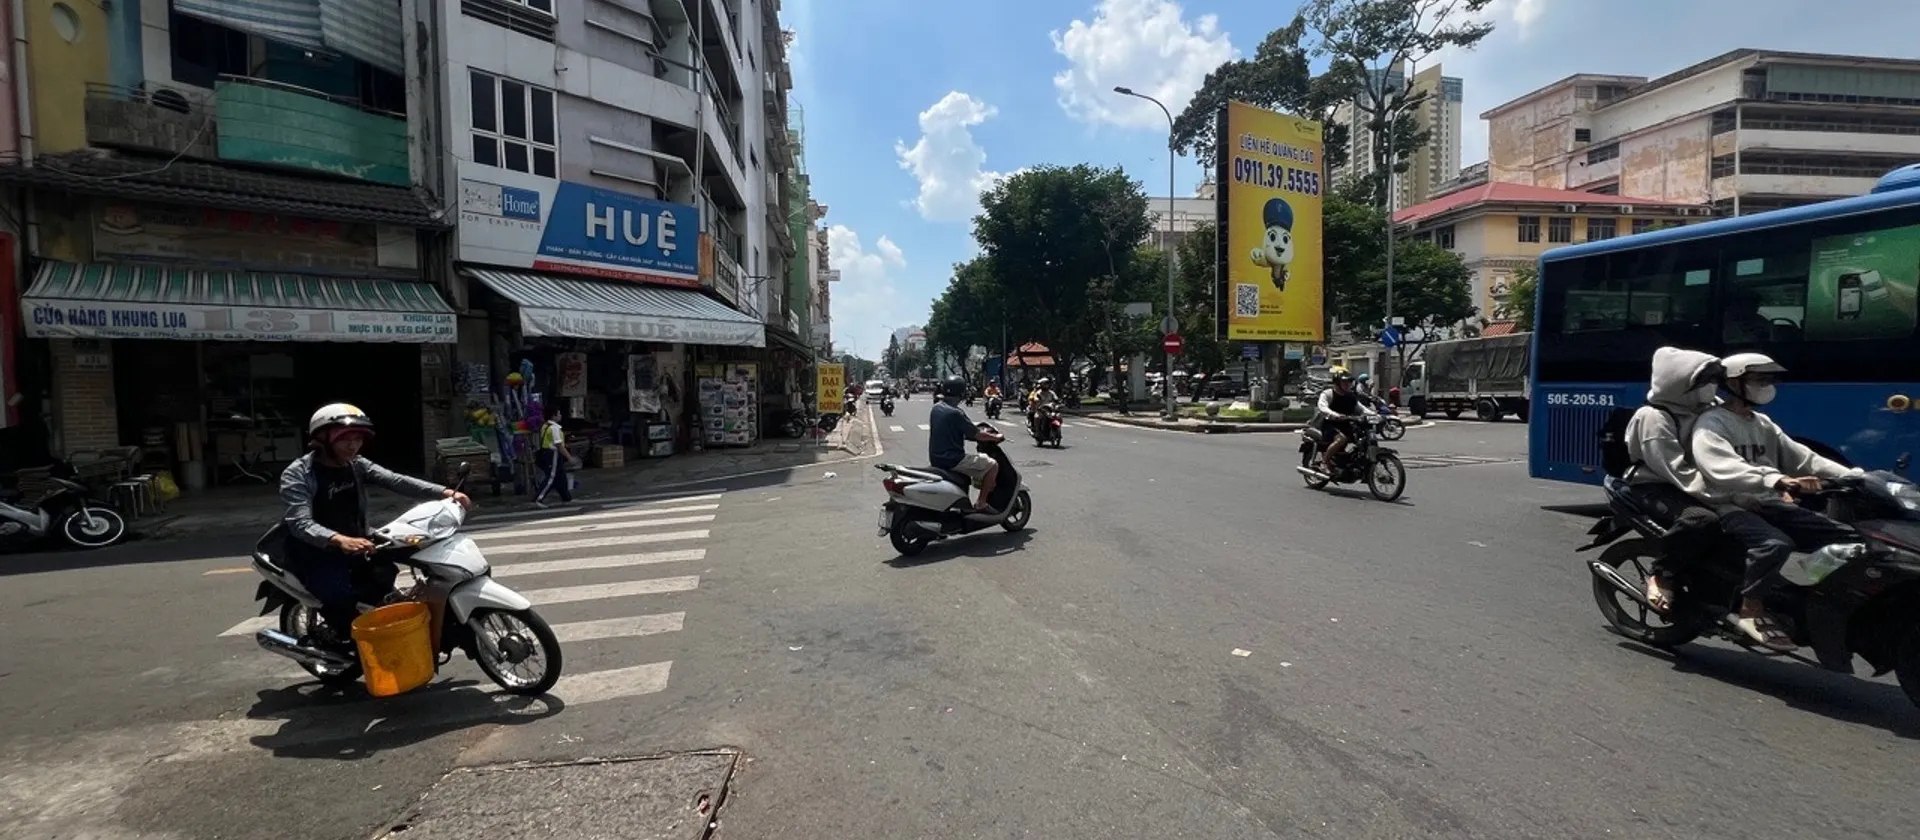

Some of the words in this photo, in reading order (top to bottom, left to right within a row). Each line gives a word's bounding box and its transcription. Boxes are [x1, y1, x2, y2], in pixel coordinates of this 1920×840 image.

[1240, 133, 1257, 150] LIÊN
[1235, 157, 1319, 195] 0911.39.5555
[503, 193, 538, 215] Home
[586, 202, 677, 257] HUỆ
[33, 303, 64, 325] CỬA
[68, 306, 107, 327] HÀNG
[112, 309, 158, 328] KHUNG
[403, 314, 433, 322] KHUNG
[1547, 393, 1615, 406] 50E-205.81
